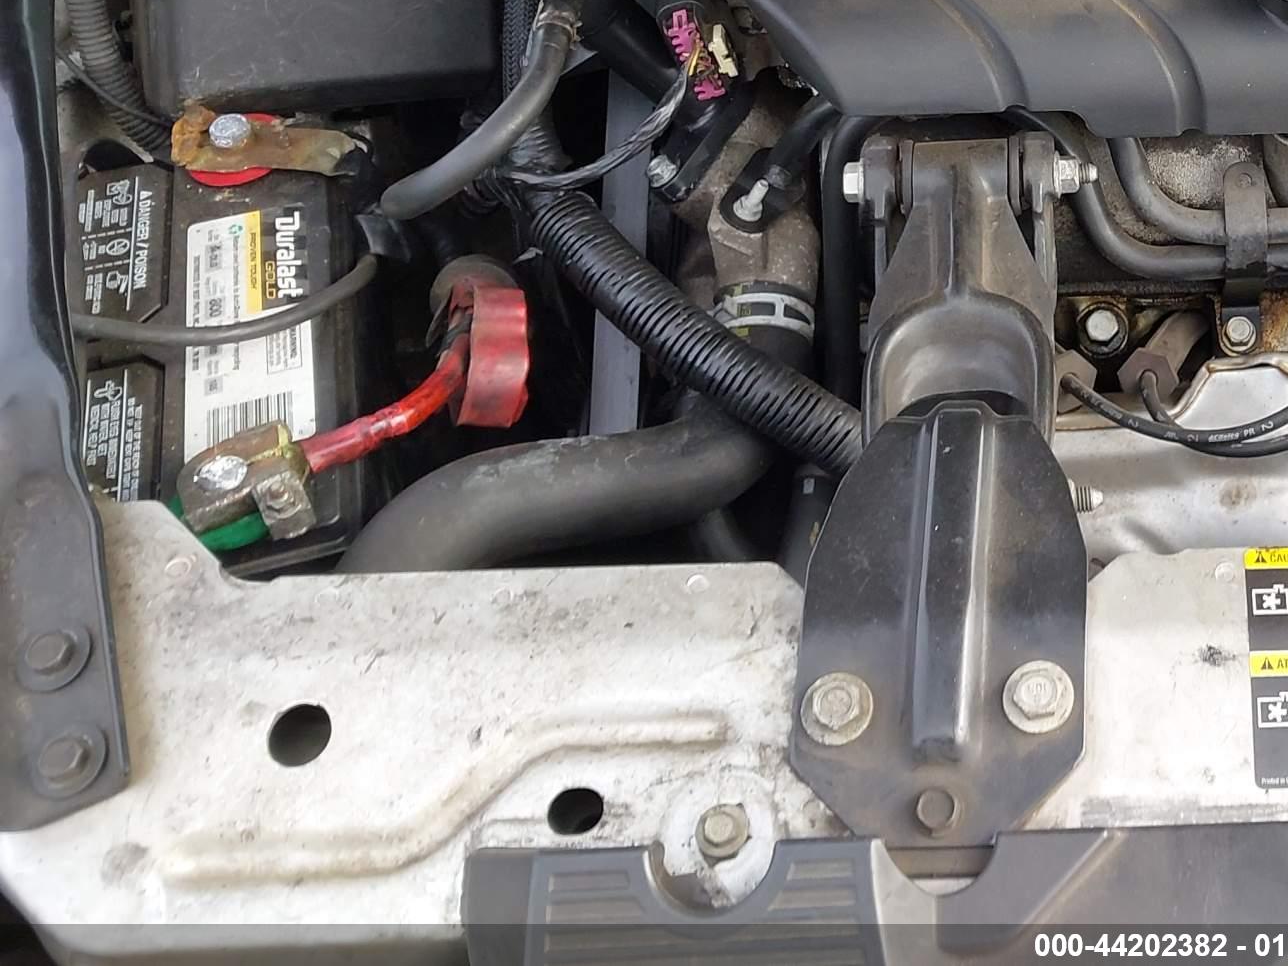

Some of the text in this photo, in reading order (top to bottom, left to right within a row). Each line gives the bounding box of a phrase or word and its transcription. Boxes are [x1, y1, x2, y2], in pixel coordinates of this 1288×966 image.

[136, 202, 151, 241] DANGER
[133, 250, 148, 289] POISON
[275, 211, 304, 298] Duralast
[265, 260, 276, 299] GOLD
